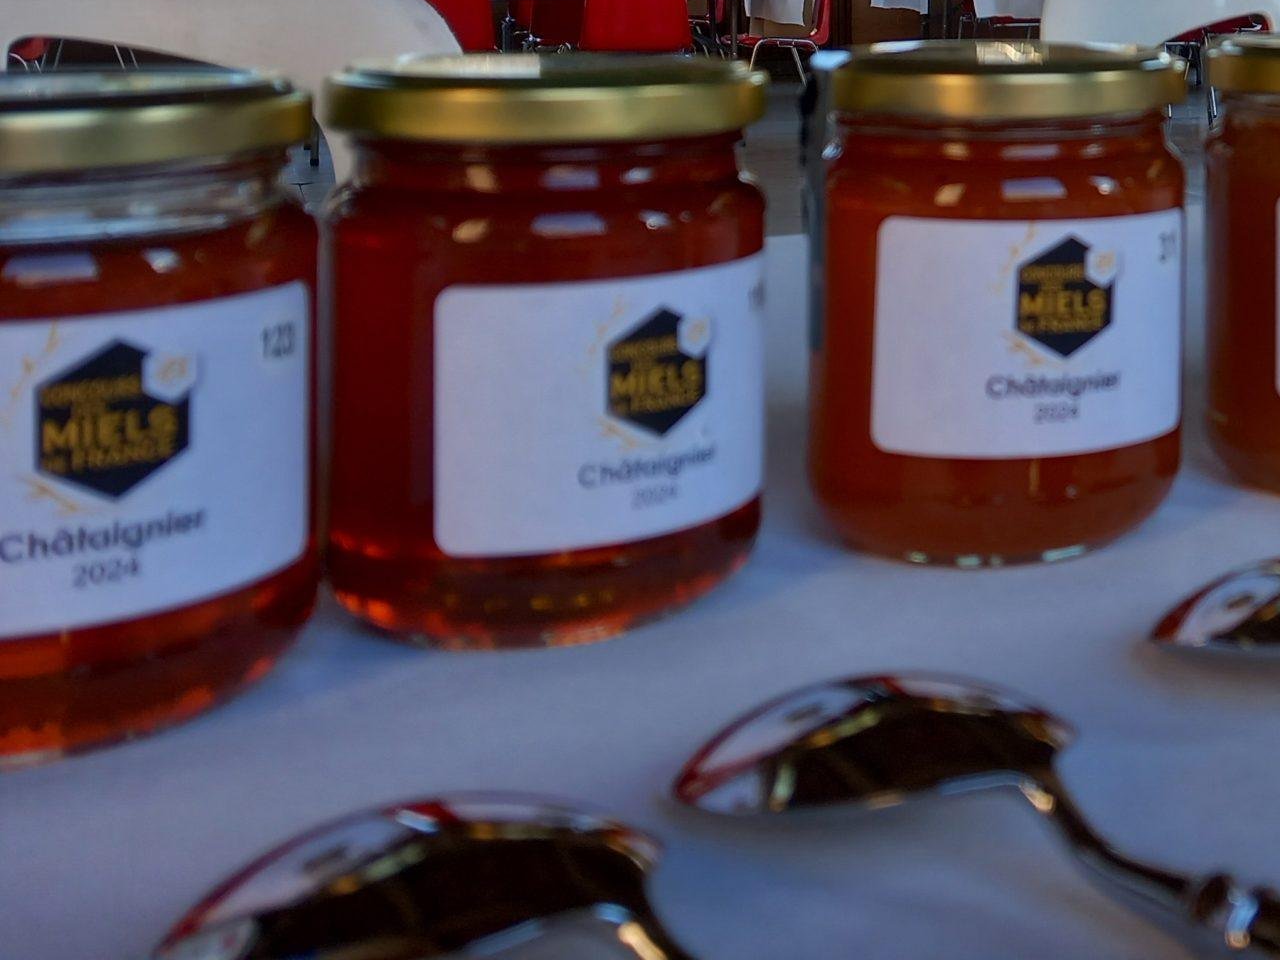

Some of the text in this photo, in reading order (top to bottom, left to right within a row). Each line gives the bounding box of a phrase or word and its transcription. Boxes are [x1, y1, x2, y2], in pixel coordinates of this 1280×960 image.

[1020, 288, 1107, 318] MIELS
[42, 404, 178, 454] MIELS
[0, 508, 206, 563] Châtaignier
[72, 557, 140, 588] 2024
